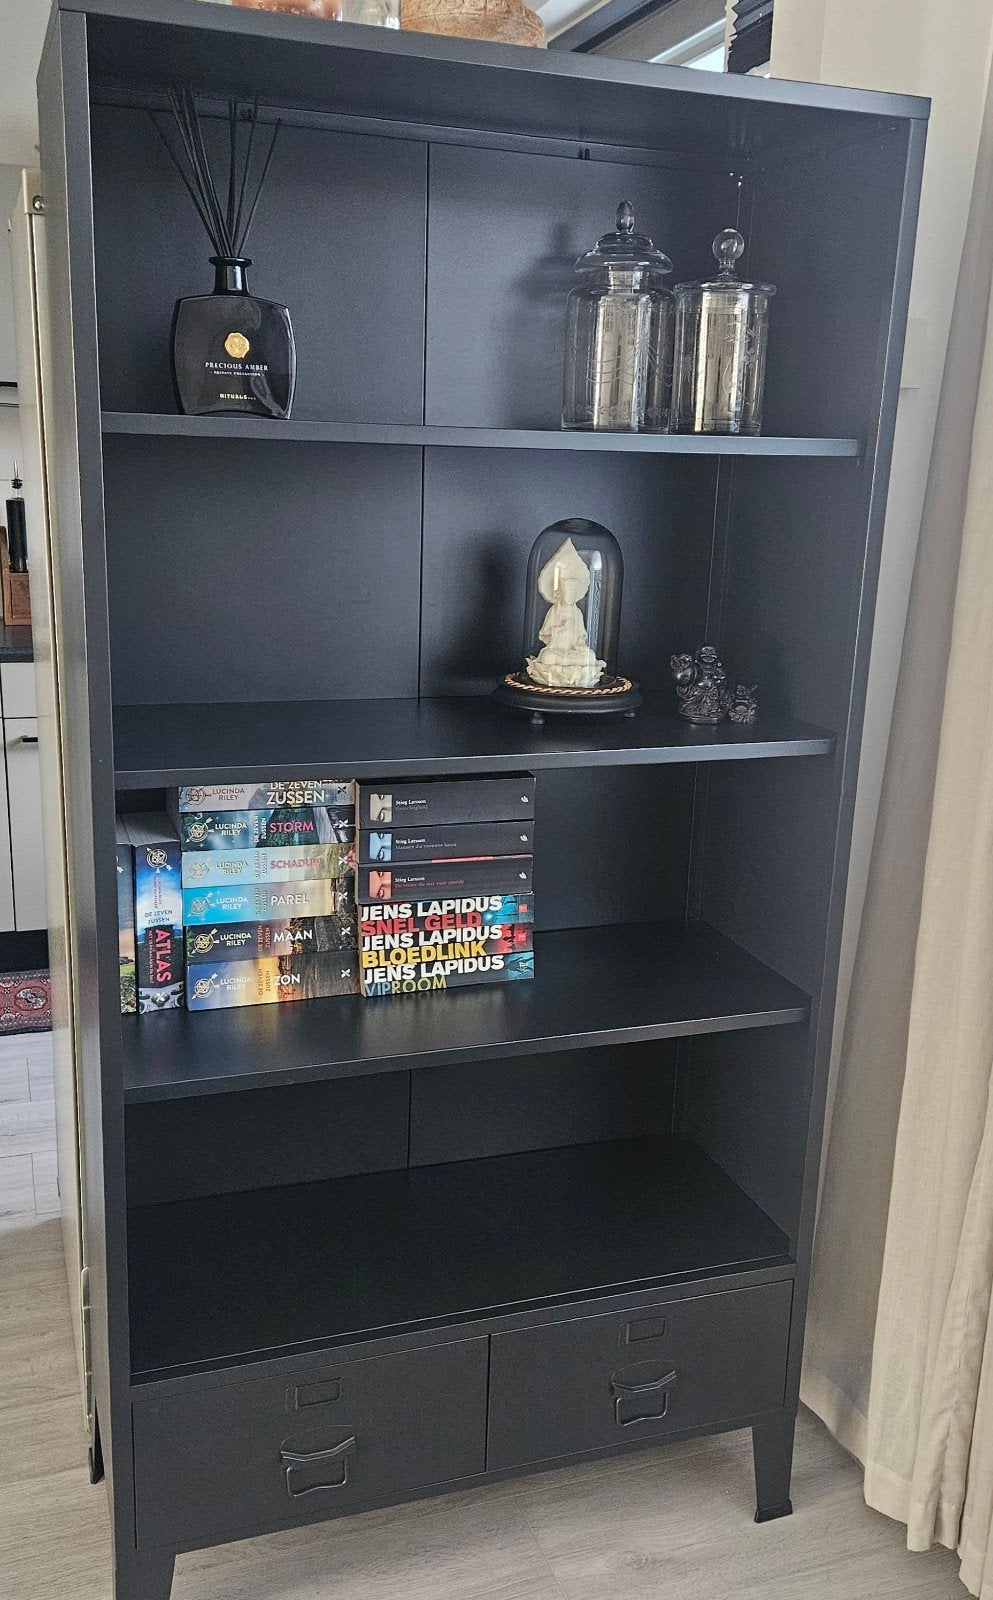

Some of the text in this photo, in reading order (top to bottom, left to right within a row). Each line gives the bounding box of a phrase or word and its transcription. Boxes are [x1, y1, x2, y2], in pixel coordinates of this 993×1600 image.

[205, 361, 242, 370] PRECIOUS
[270, 780, 322, 790] DE ZEVEN
[212, 787, 245, 795] LUCINDA
[266, 789, 325, 805] ZUSSEN
[215, 822, 248, 830] LUCINDA
[269, 820, 314, 833] STORM
[220, 828, 242, 836] RILEY
[254, 834, 259, 843] DE
[216, 860, 248, 869] LUCINDA
[269, 858, 321, 870] SCHADUW
[222, 867, 243, 875] RILEY
[216, 896, 248, 905] LUCINDA
[271, 894, 309, 906] PAREL
[361, 903, 412, 921] JENS
[417, 895, 503, 917] LAPIDUS
[153, 909, 173, 917] ZEVEN
[361, 912, 482, 937] SNEL GELD
[220, 932, 252, 941] LUCINDA
[273, 929, 313, 943] MAAN
[362, 932, 414, 951] JENS
[418, 924, 503, 946] LAPIDUS
[226, 939, 246, 947] RILEY
[257, 944, 263, 952] DE
[155, 929, 172, 982] ATLAS
[362, 940, 487, 969] BLOEDLINK
[364, 964, 416, 984] JENS
[420, 954, 505, 978] LAPIDUS
[220, 977, 252, 986] LUCINDA
[274, 973, 301, 986] ZON
[258, 988, 263, 996] DE
